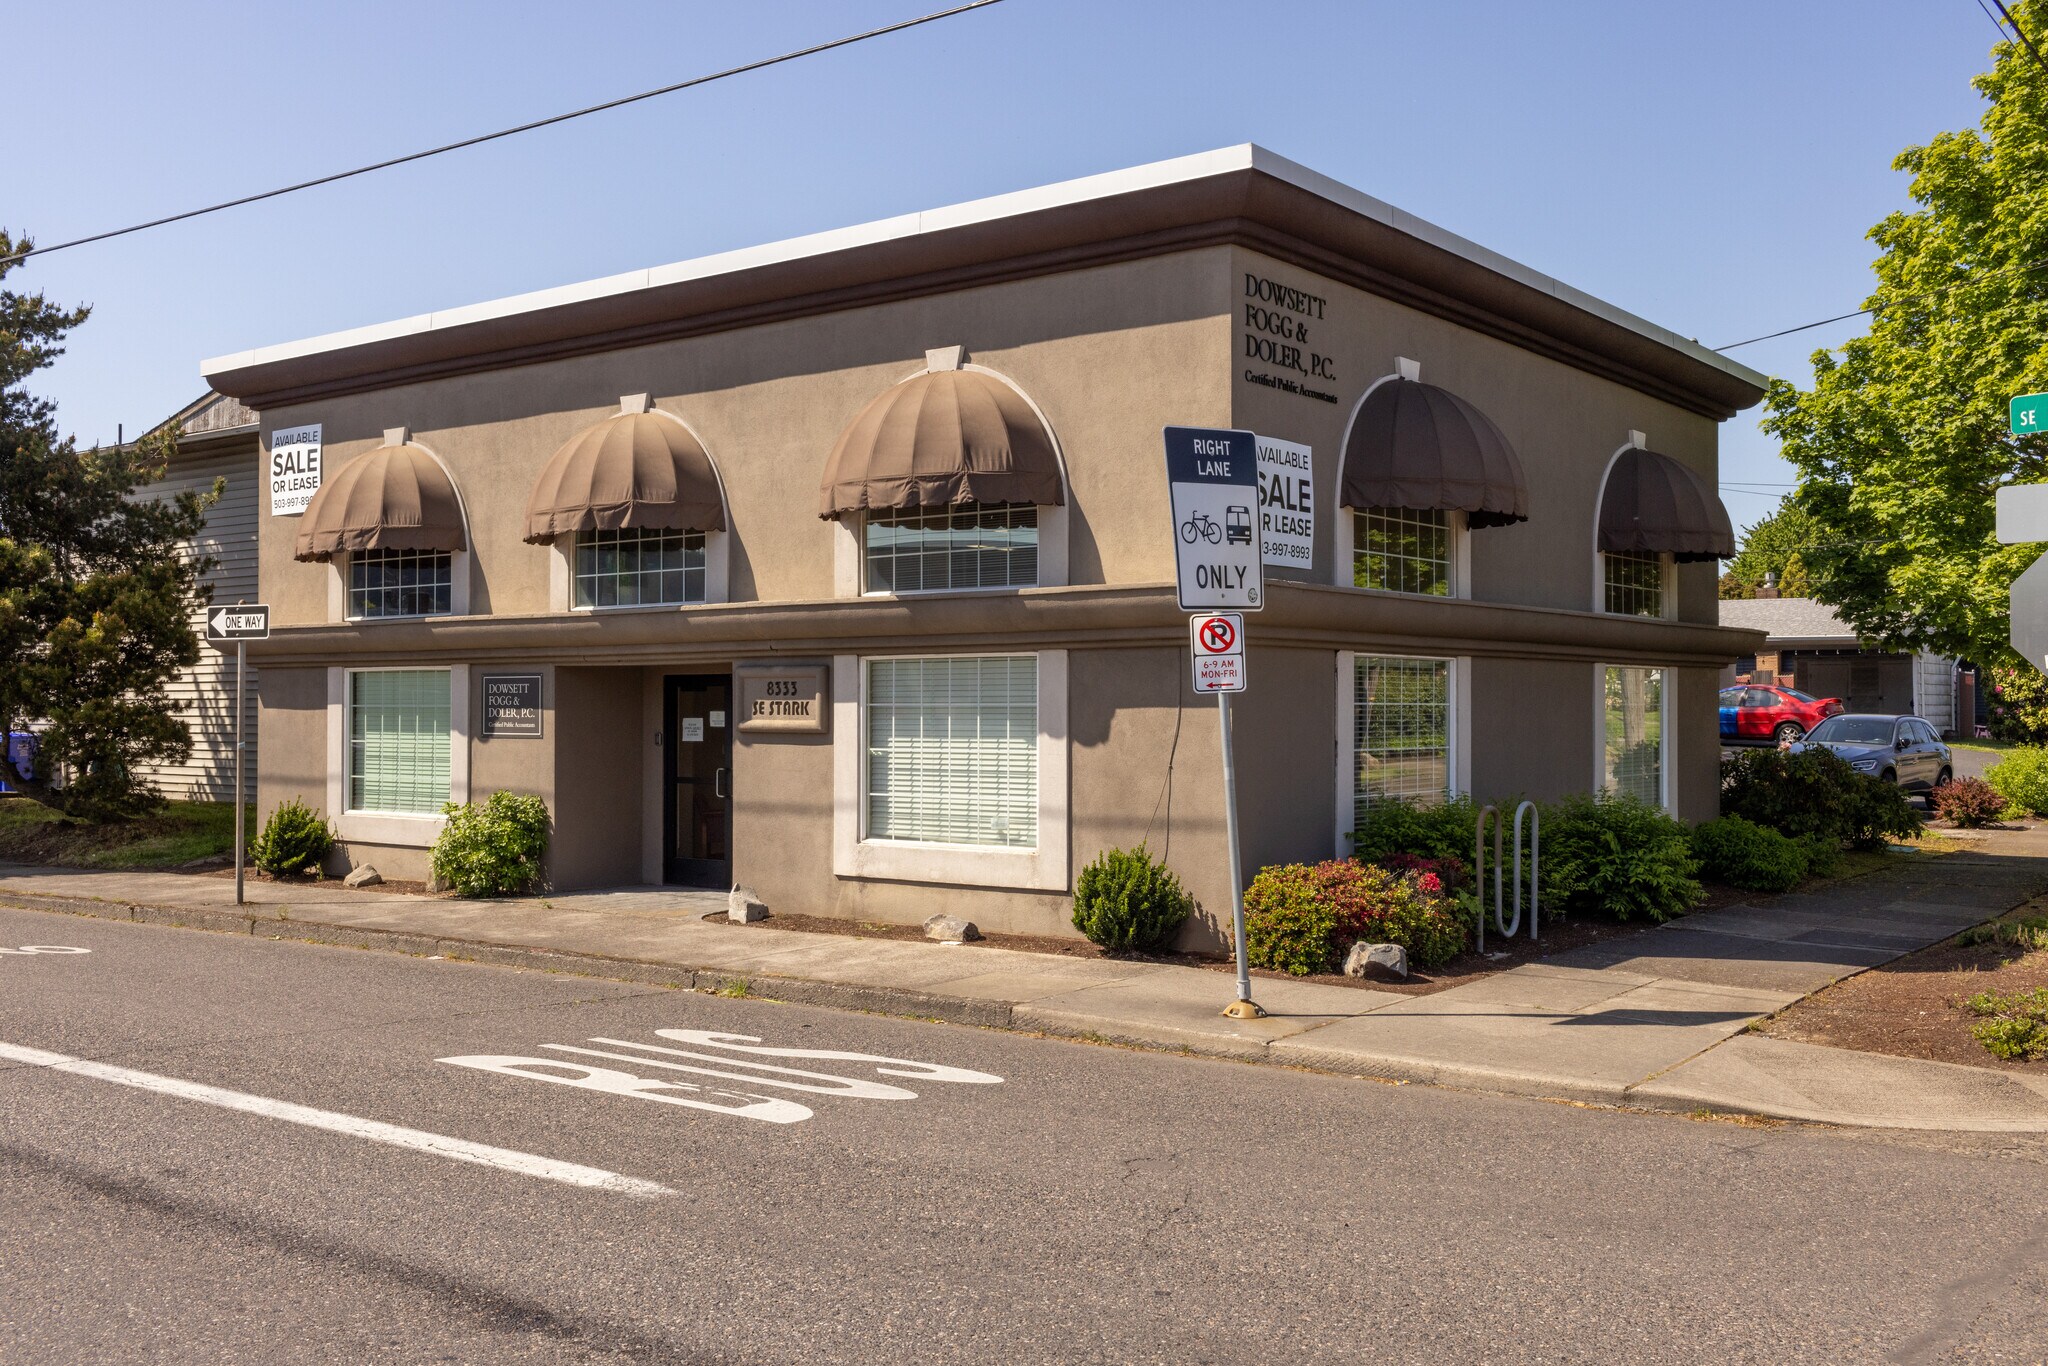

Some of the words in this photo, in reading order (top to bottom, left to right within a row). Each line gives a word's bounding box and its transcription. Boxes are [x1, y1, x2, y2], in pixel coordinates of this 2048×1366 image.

[1245, 273, 1326, 320] DOWSETT
[1245, 303, 1292, 339] FOGG
[1295, 321, 1308, 344] &
[1245, 333, 1308, 377] DOLER,
[1310, 353, 1336, 381] P.C.
[1245, 369, 1276, 389] Certified
[1277, 377, 1298, 395] Public
[1299, 384, 1338, 404] Accountants
[2020, 410, 2036, 426] SE
[274, 430, 318, 448] AVAILABLE
[1193, 439, 1230, 456] RIGHT
[272, 448, 318, 477] SALE
[1257, 445, 1309, 471] VAILABLE
[1197, 460, 1232, 477] LANE
[272, 480, 286, 493] OR
[288, 476, 318, 492] LEASE
[1261, 513, 1271, 532] R
[1275, 513, 1311, 538] LEASE
[1261, 541, 1310, 560] 3-997-8993
[1196, 564, 1247, 590] ONLY
[225, 616, 242, 629] ONE
[244, 615, 262, 628] WAY
[1203, 661, 1218, 669] 6-9
[1221, 660, 1234, 668] AM
[1201, 669, 1238, 679] MON-FRI
[488, 683, 530, 694] DOWSETT
[767, 681, 798, 696] 8333
[488, 695, 512, 706] FOGG
[513, 696, 520, 706] &
[752, 701, 765, 716] SE
[769, 701, 810, 716] STARK
[488, 707, 520, 719] DOLER,
[521, 707, 536, 718] P.C.
[432, 1027, 1005, 1125] BUS
